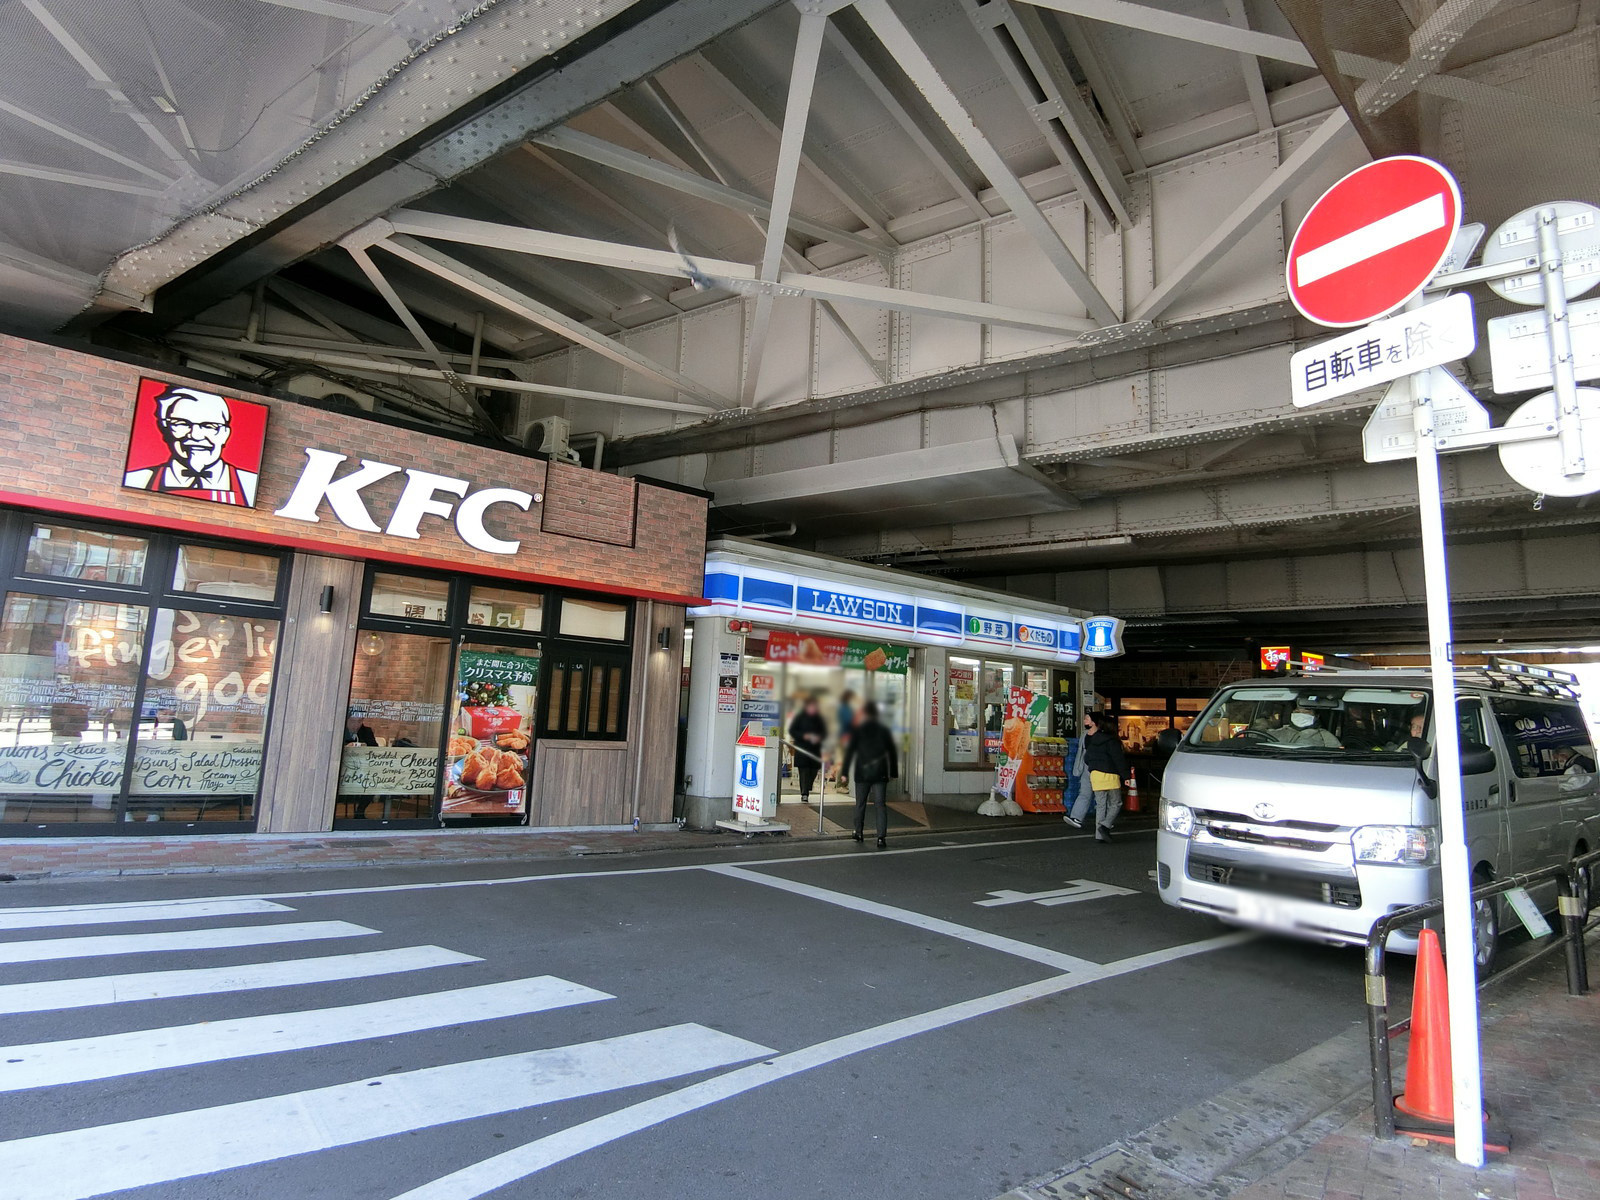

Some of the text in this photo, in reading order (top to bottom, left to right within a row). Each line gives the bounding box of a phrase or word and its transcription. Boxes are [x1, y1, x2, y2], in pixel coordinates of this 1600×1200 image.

[1304, 319, 1455, 392] 自転車を除く
[273, 447, 534, 555] KFC
[811, 590, 903, 624] LAWSON
[983, 621, 1004, 636] 野菜
[1029, 629, 1053, 643] くだもの
[464, 666, 533, 683] クリスマス予約
[931, 668, 939, 726] トイレ未設置
[182, 752, 219, 771] Salad
